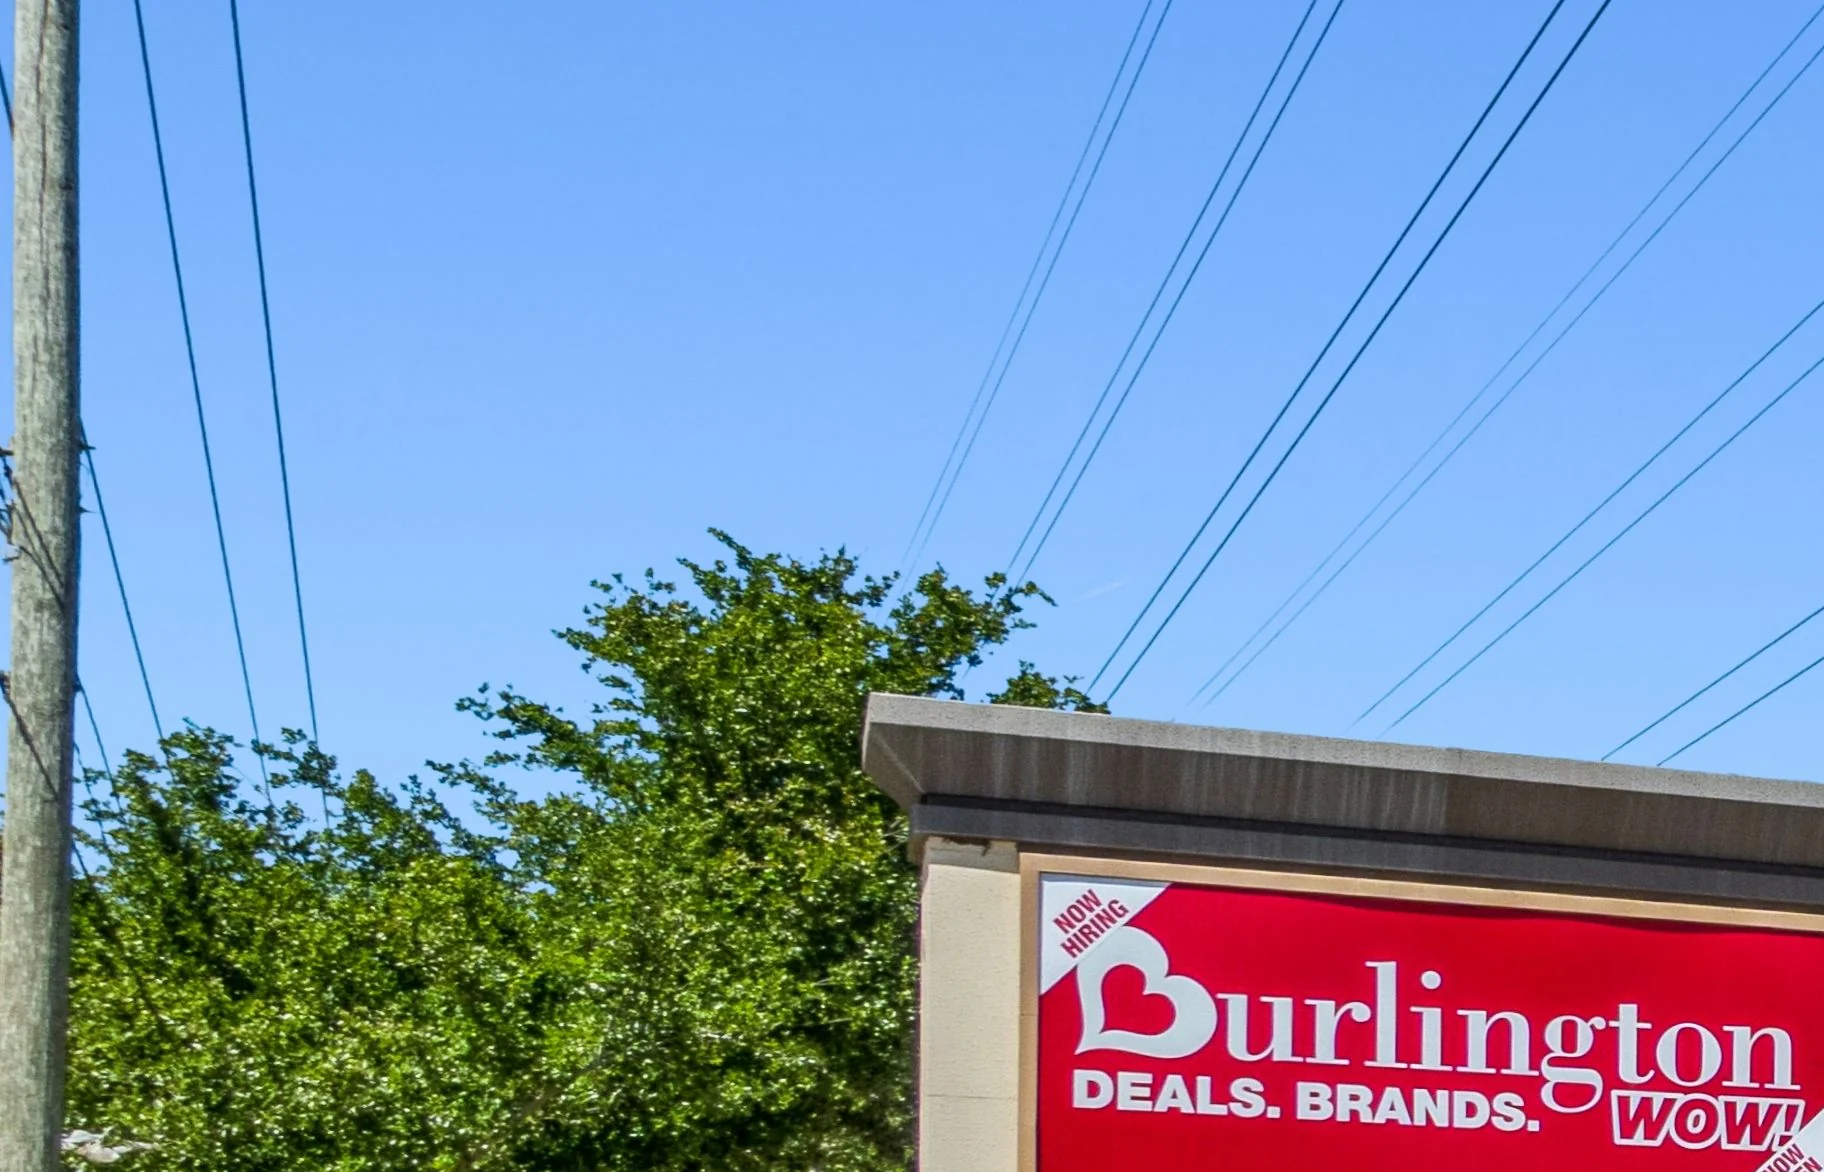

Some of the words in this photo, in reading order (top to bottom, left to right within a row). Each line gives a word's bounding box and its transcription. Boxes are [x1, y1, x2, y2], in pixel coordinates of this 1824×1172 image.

[1053, 888, 1102, 934] NOW
[1060, 898, 1129, 959] HIRING
[1073, 926, 1802, 1114] Burlington
[1073, 1070, 1280, 1120] DEALS.
[1296, 1082, 1541, 1133] BRANDS.
[1610, 1089, 1806, 1153] WOW!
